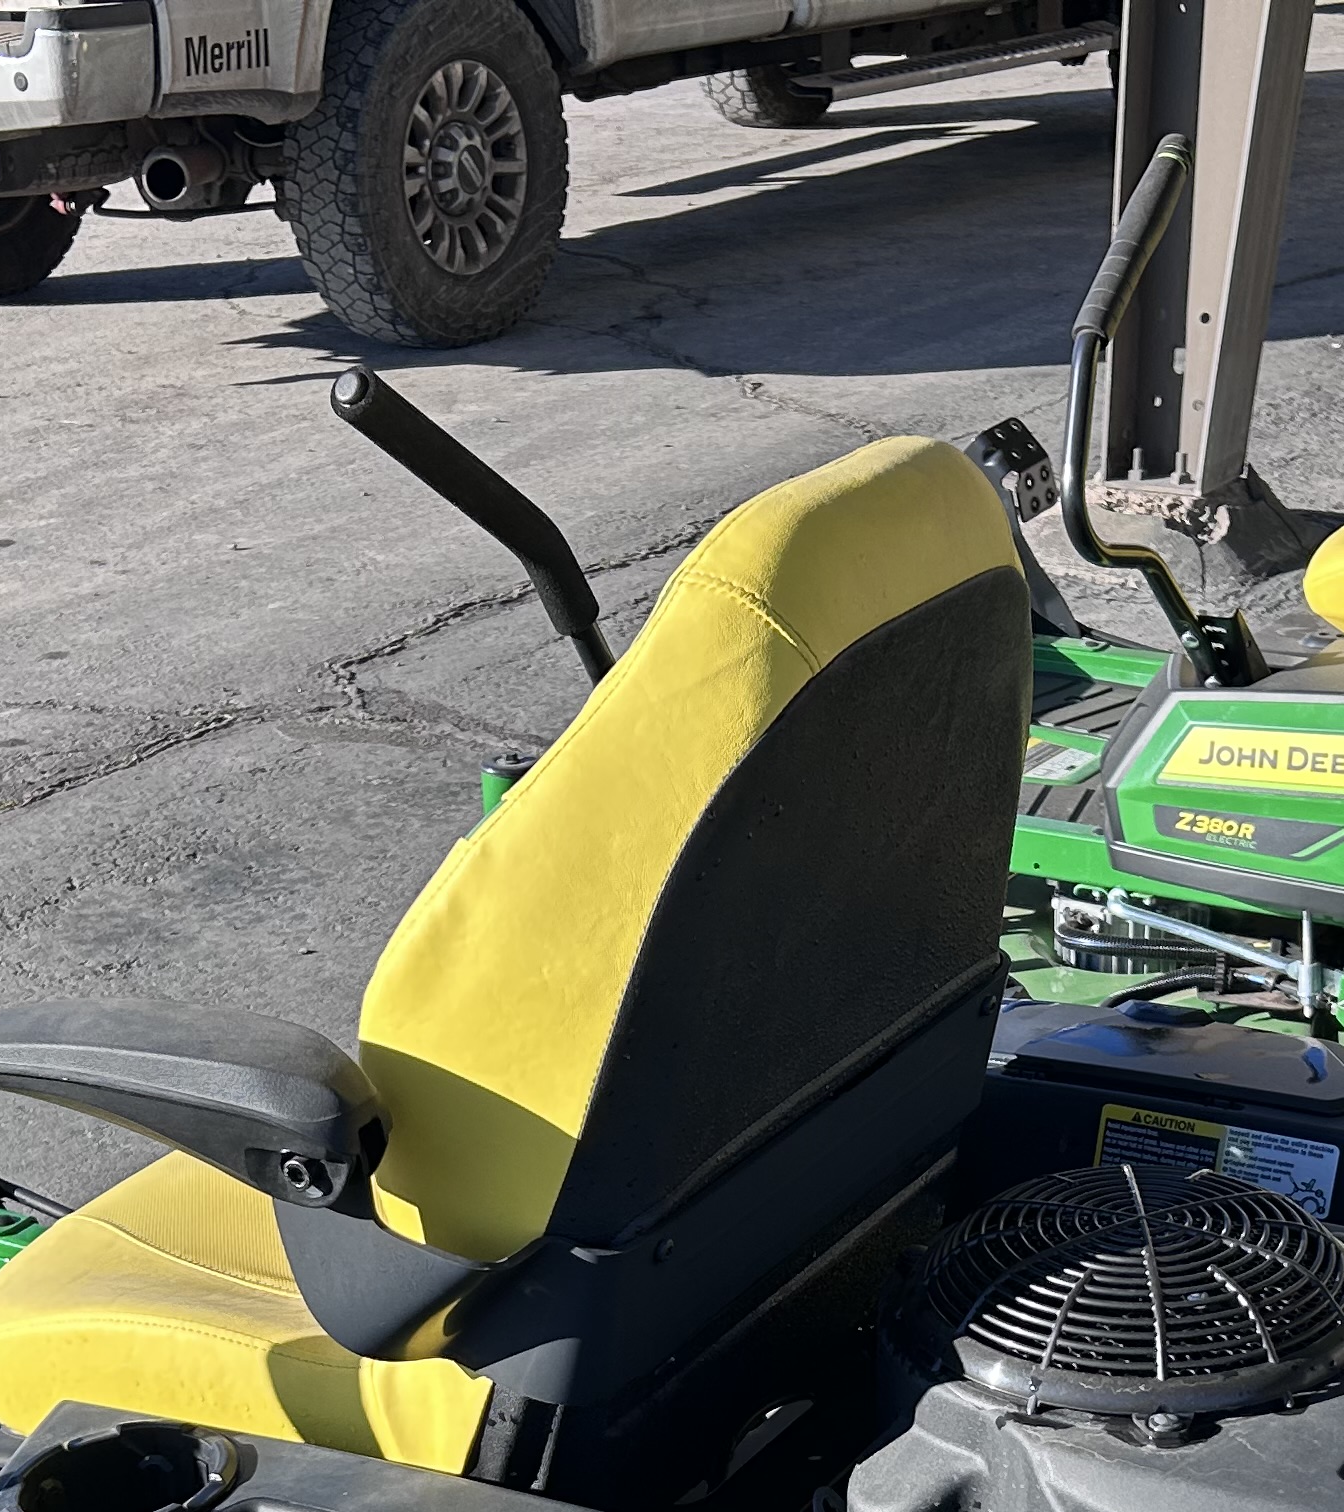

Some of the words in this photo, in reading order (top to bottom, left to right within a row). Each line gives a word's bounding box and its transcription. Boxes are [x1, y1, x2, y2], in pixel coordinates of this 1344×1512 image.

[185, 28, 269, 76] Merrill
[1198, 741, 1278, 770] JOHN
[1174, 811, 1255, 840] Z380R
[1206, 833, 1258, 849] ELECTRIC
[1143, 1114, 1196, 1133] CAUTION
